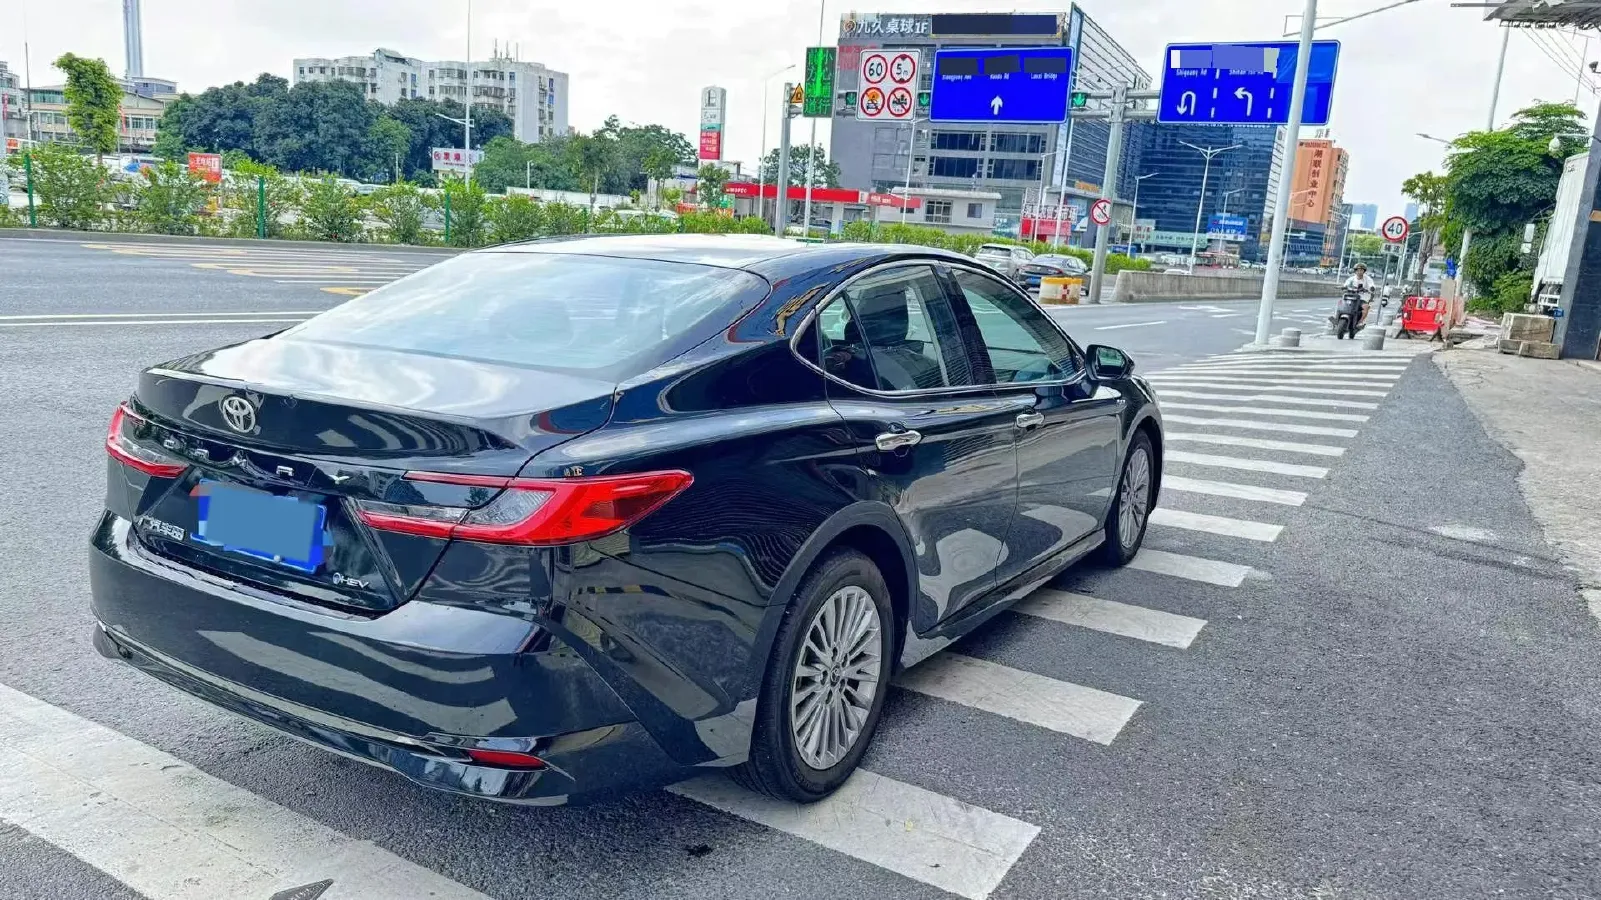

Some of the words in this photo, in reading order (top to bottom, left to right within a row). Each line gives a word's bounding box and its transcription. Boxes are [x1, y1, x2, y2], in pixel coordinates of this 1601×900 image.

[868, 62, 883, 77] 60
[896, 63, 909, 76] 5m
[1387, 222, 1403, 235] 40
[340, 575, 369, 589] HEV
